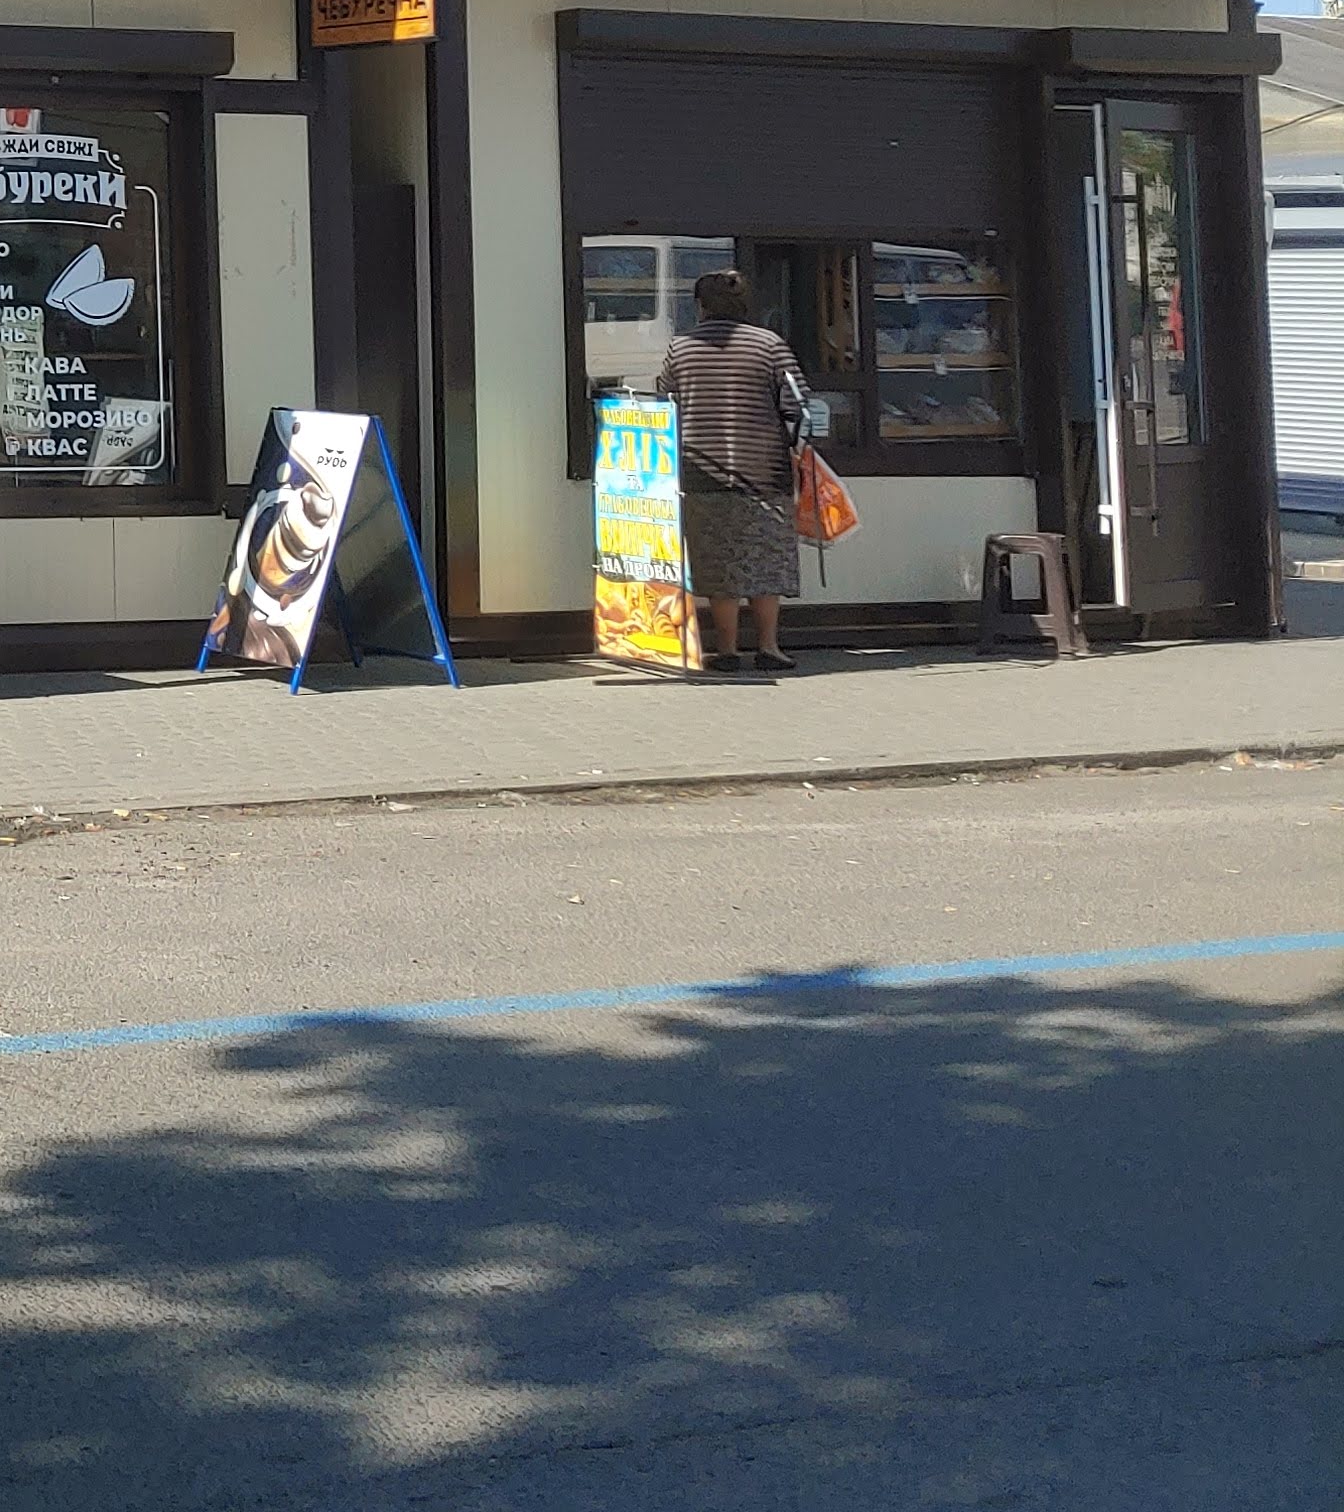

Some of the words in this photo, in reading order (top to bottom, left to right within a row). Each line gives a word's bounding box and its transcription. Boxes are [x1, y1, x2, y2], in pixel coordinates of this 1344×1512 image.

[44, 139, 94, 157] СВІЖІ
[25, 357, 87, 375] КАВА
[26, 383, 98, 403] ЛАТТЕ
[27, 410, 154, 431] МОРОЗИВО
[27, 437, 89, 457] КВАС
[598, 430, 673, 475] ХЛІБ
[602, 557, 622, 575] НА
